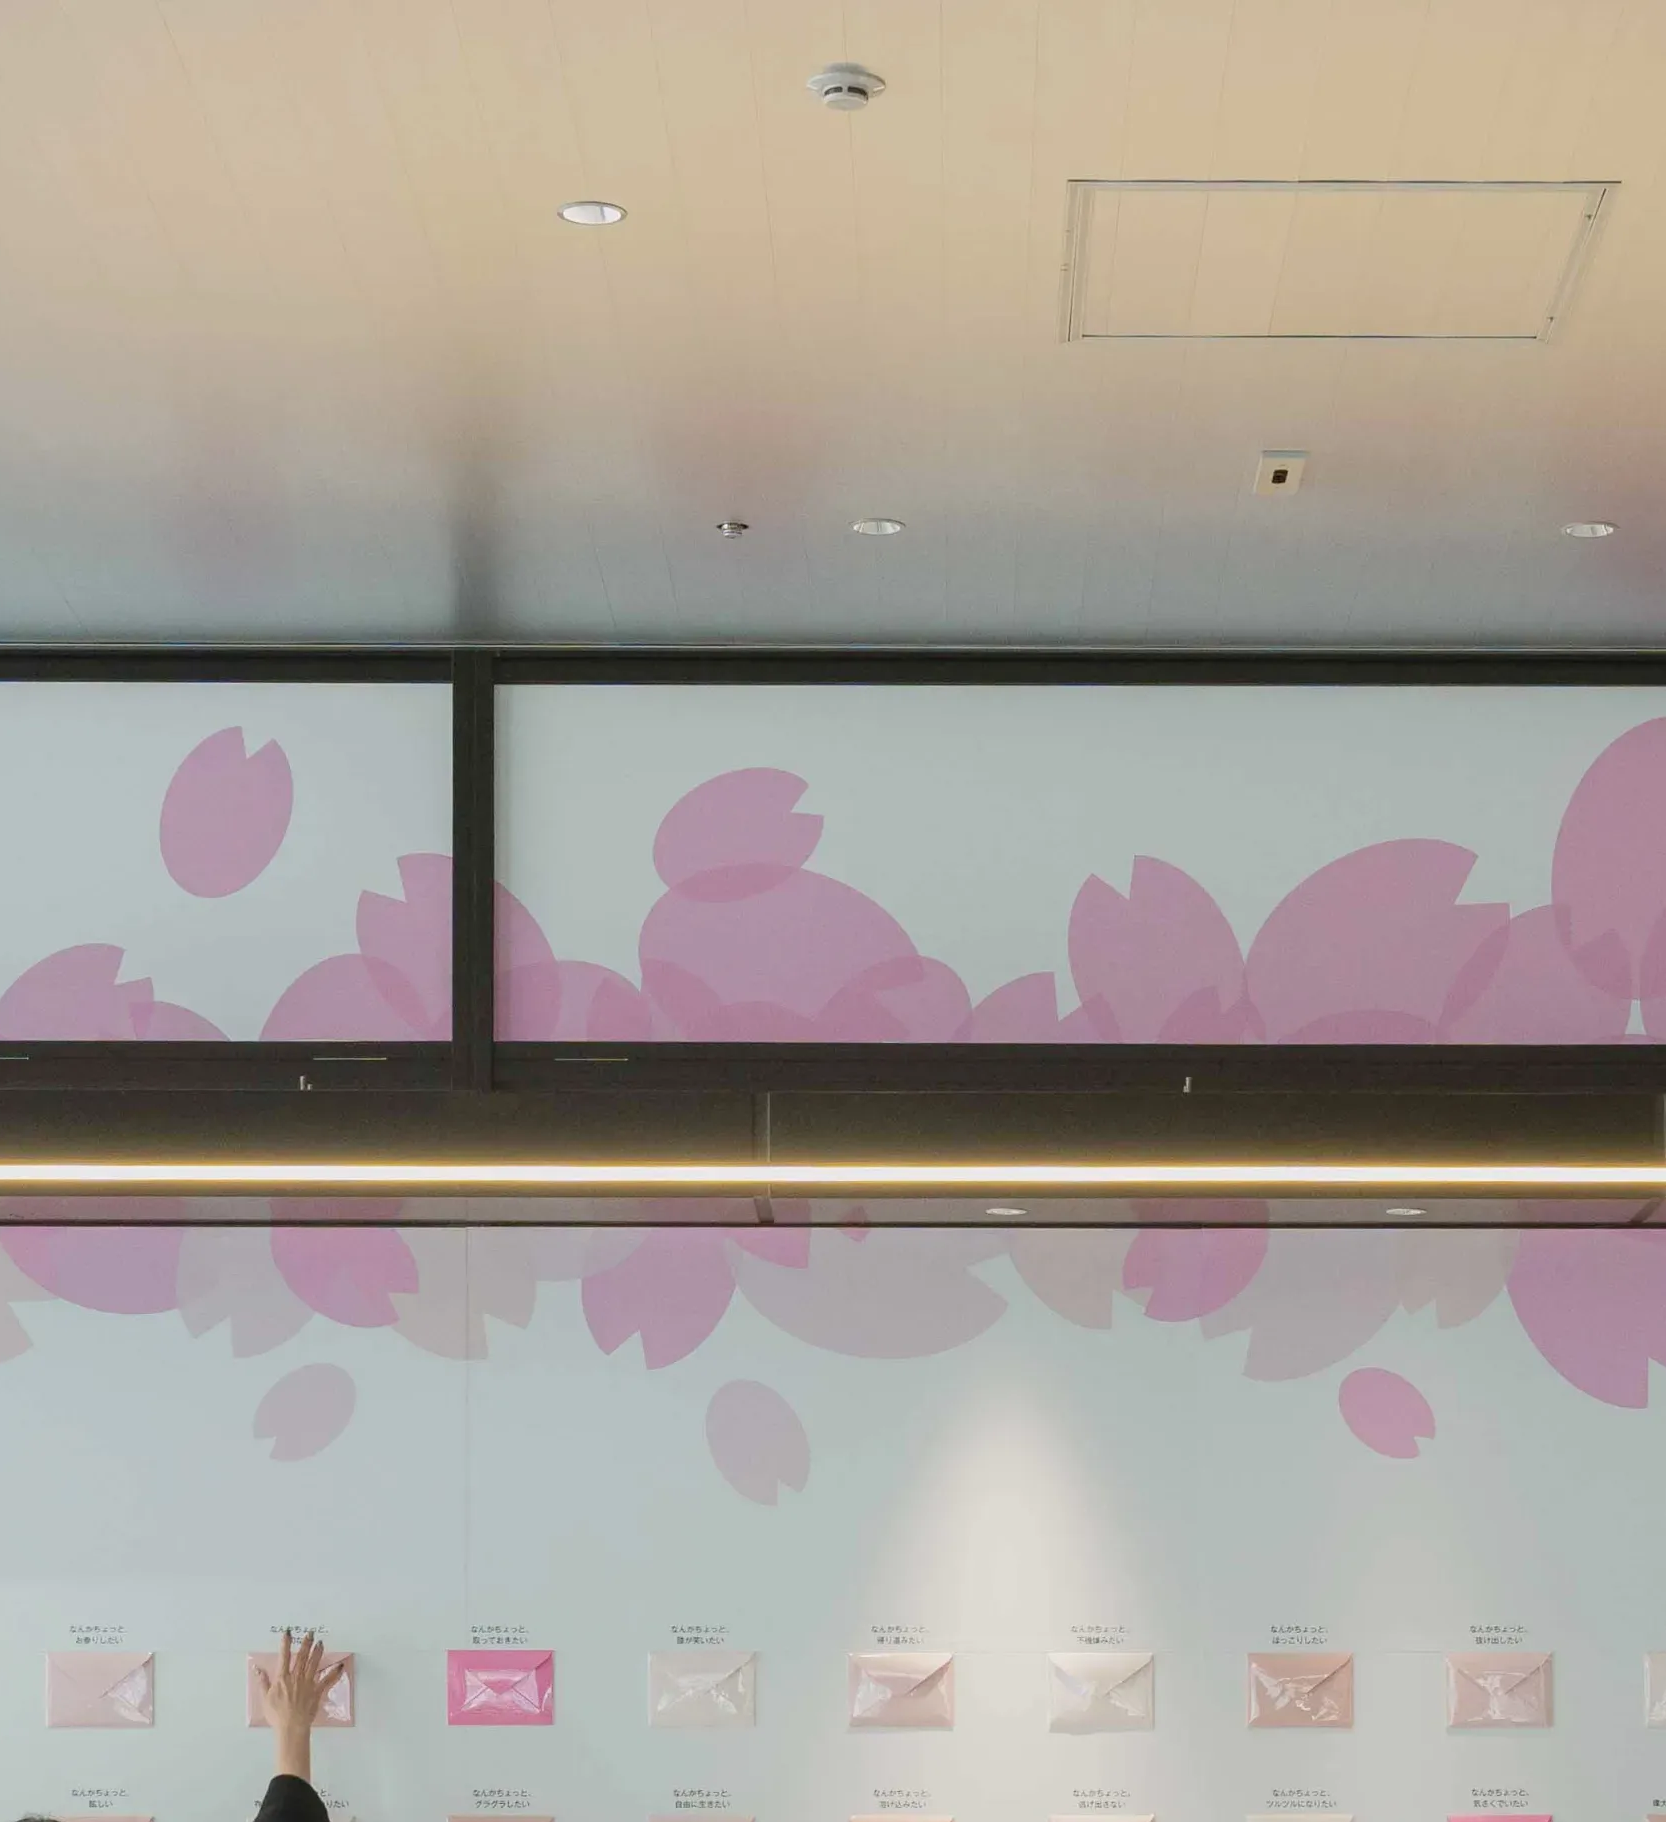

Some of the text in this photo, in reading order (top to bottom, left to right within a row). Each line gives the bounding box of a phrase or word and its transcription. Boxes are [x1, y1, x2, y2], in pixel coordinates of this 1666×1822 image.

[69, 1625, 127, 1634] なんかちょっと、
[470, 1625, 529, 1634] なんかちょっと、
[669, 1624, 729, 1634] なんかちょっと、
[871, 1625, 929, 1634] なんかちょっと、
[1070, 1625, 1129, 1634] なんかちょっと、
[1271, 1624, 1328, 1634] なんかちょっと、
[1469, 1624, 1527, 1634] なんかちょっと、
[473, 1635, 528, 1645] 取っておきたい
[72, 1788, 129, 1798] なんかちょっと、
[473, 1788, 531, 1798] なんかちょっと、
[673, 1789, 732, 1798] なんかちょっと、
[873, 1789, 931, 1799] なんかちょっと、
[1073, 1789, 1130, 1799] なんかちょっと、
[1273, 1788, 1330, 1798] なんかちょっと、
[1471, 1788, 1529, 1798] なんかちょっと、
[475, 1799, 530, 1809] グラグラしたい
[675, 1799, 730, 1809] 自由に生きたい
